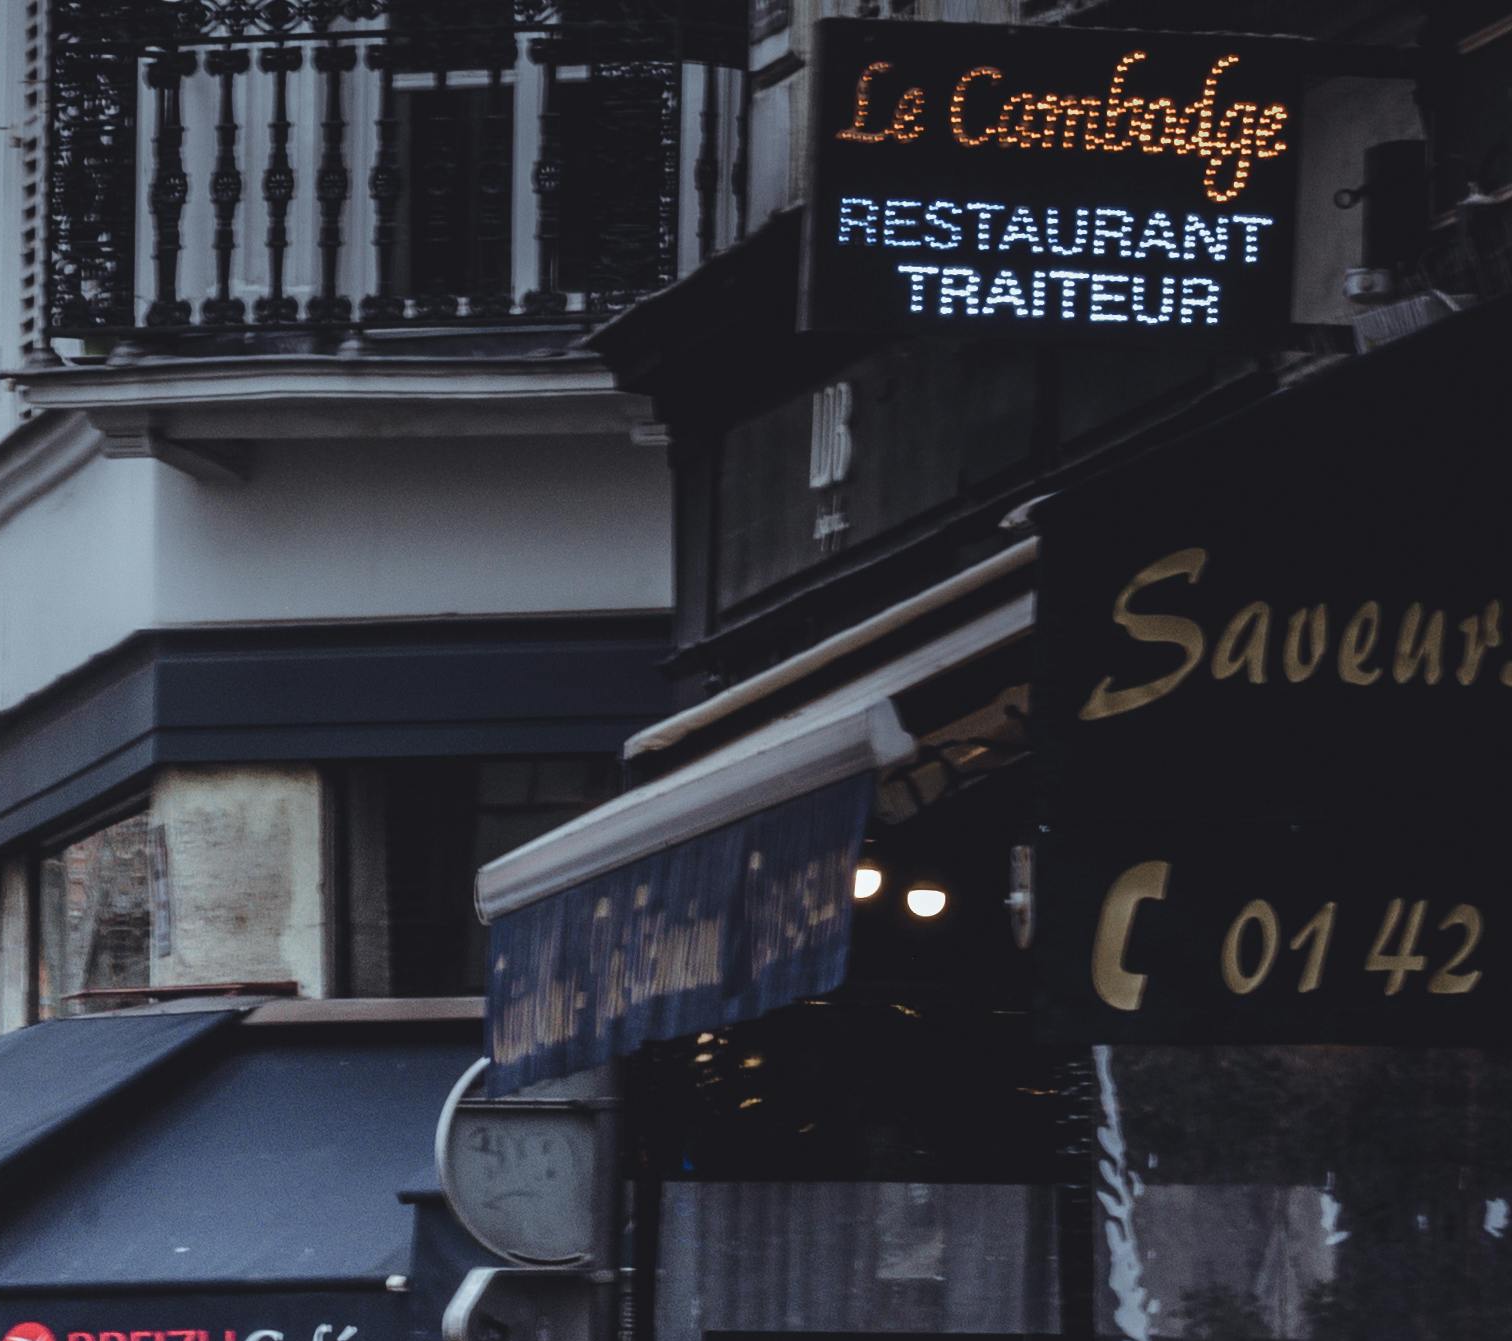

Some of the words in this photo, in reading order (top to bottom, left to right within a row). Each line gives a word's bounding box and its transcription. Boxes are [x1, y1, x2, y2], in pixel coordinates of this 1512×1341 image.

[835, 61, 927, 143] Le
[949, 49, 1290, 203] Cambodge
[837, 197, 1274, 264] RESTAURANT
[896, 264, 1223, 326] TRAITEUR
[1220, 898, 1337, 995] 01
[1363, 898, 1485, 996] 42
